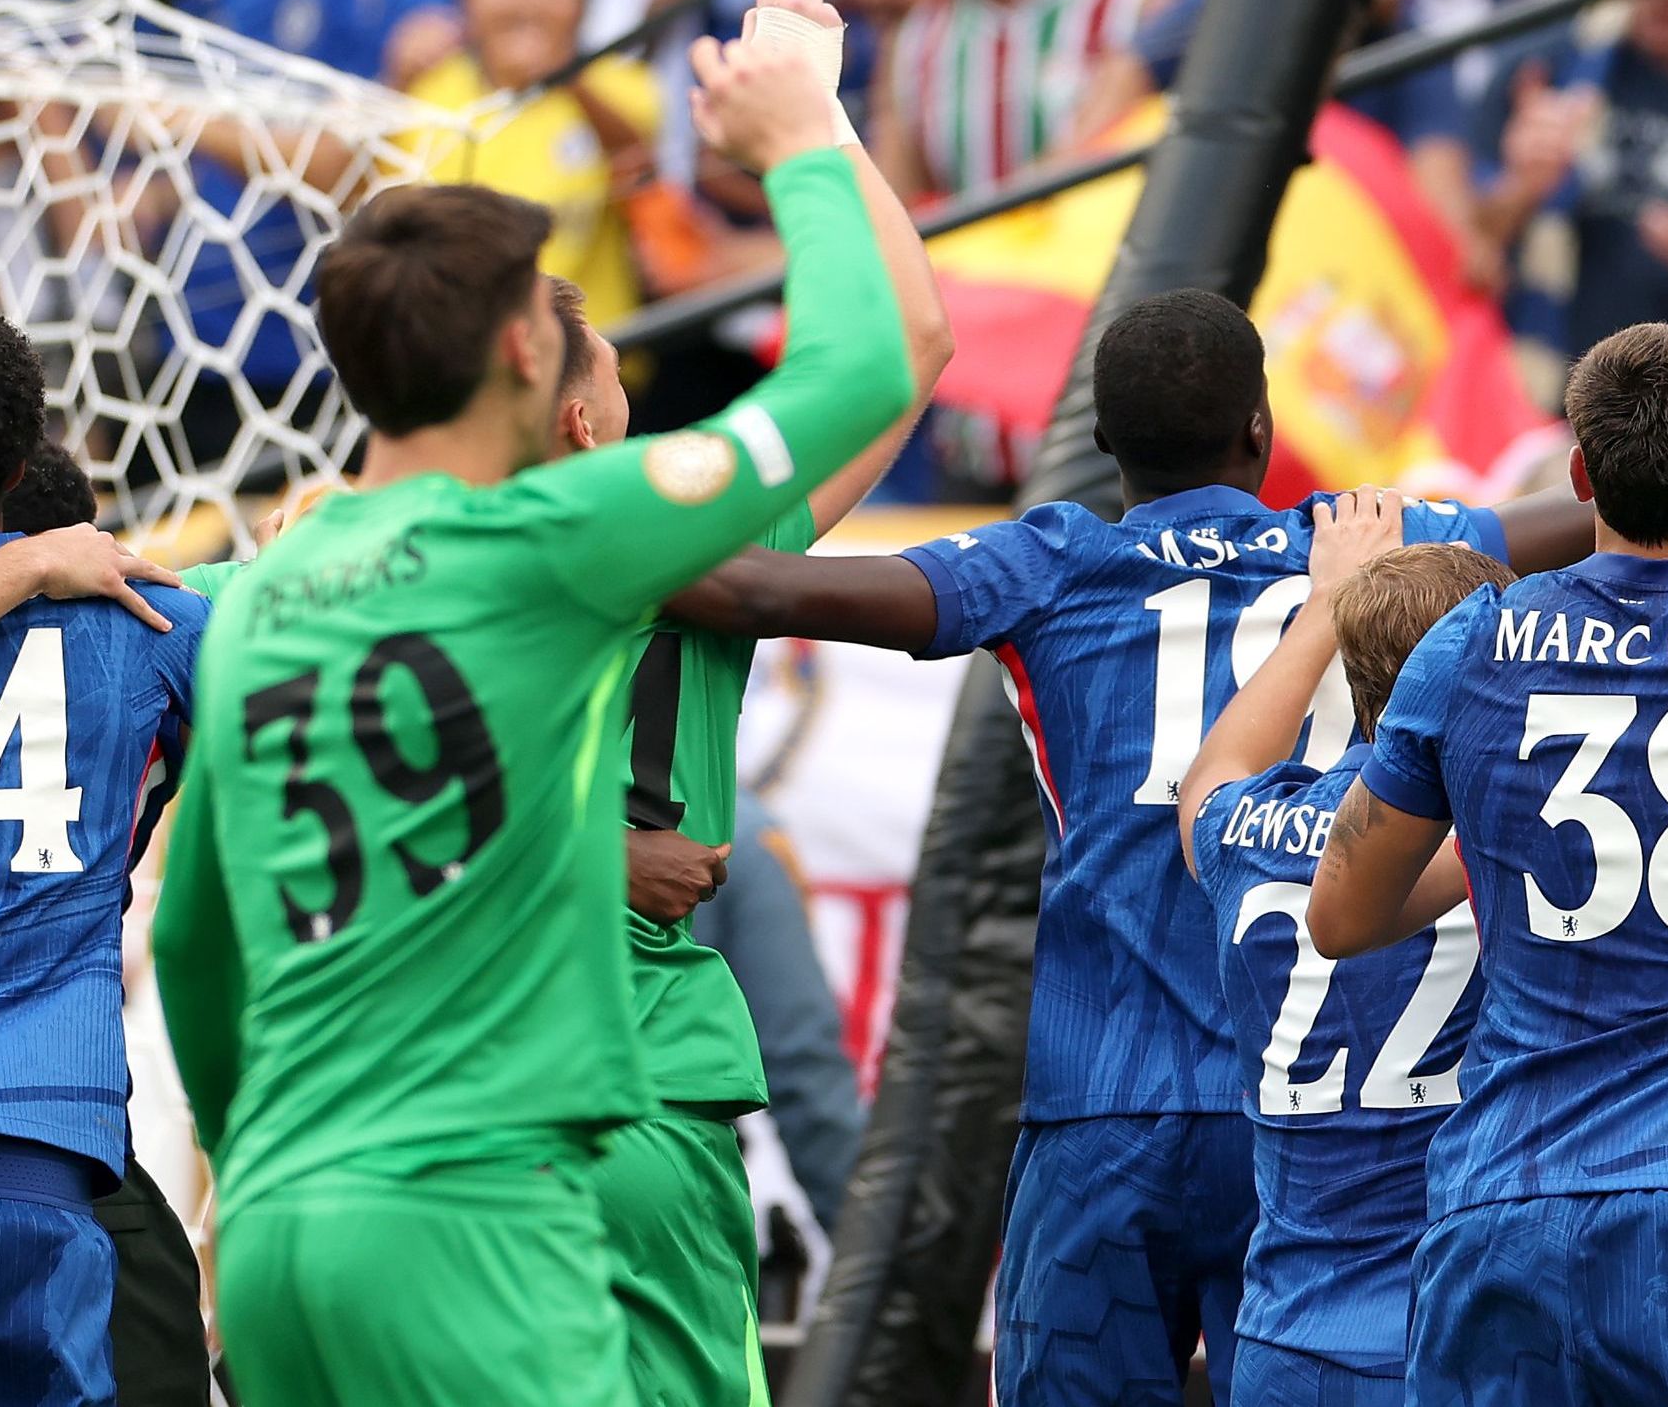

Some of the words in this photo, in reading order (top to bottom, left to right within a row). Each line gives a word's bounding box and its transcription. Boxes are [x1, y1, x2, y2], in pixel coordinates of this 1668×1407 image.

[1493, 608, 1653, 666] MARC
[244, 632, 507, 943] 39
[1221, 795, 1336, 859] DEWSB
[1232, 880, 1481, 1116] 22
